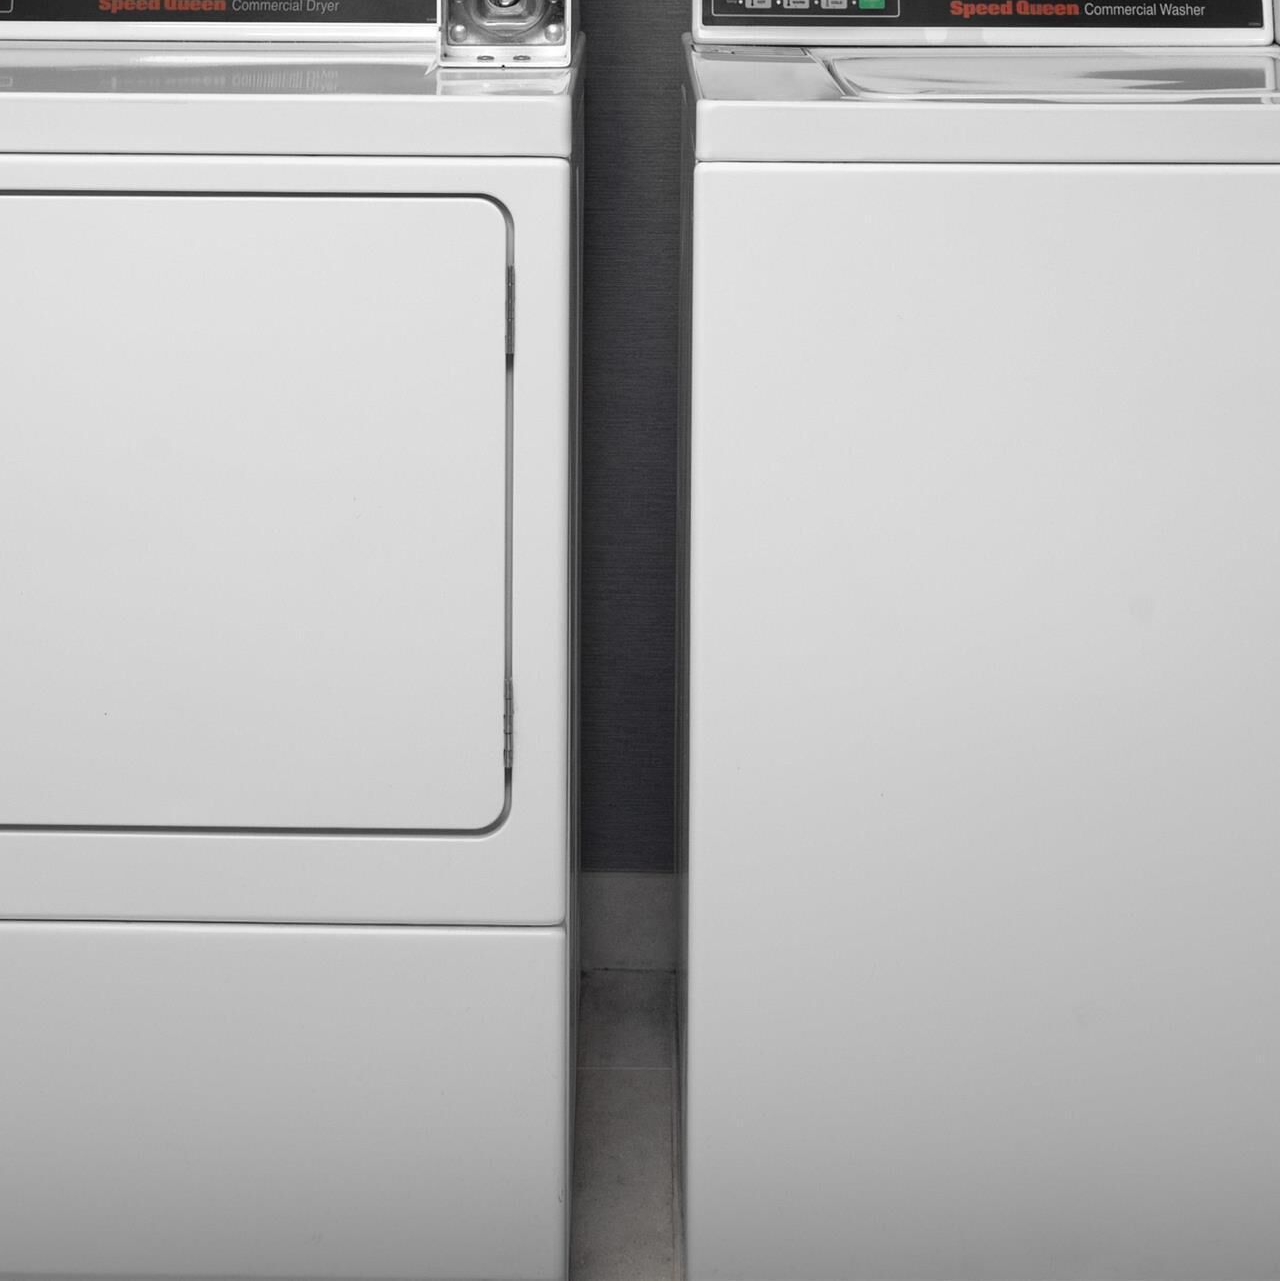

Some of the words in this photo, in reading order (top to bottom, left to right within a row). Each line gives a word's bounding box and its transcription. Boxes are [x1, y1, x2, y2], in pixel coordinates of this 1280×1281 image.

[949, 0, 1013, 18] Speed
[1016, 0, 1080, 16] Queen
[1083, 2, 1157, 17] Commercial
[1159, 3, 1207, 17] Washer
